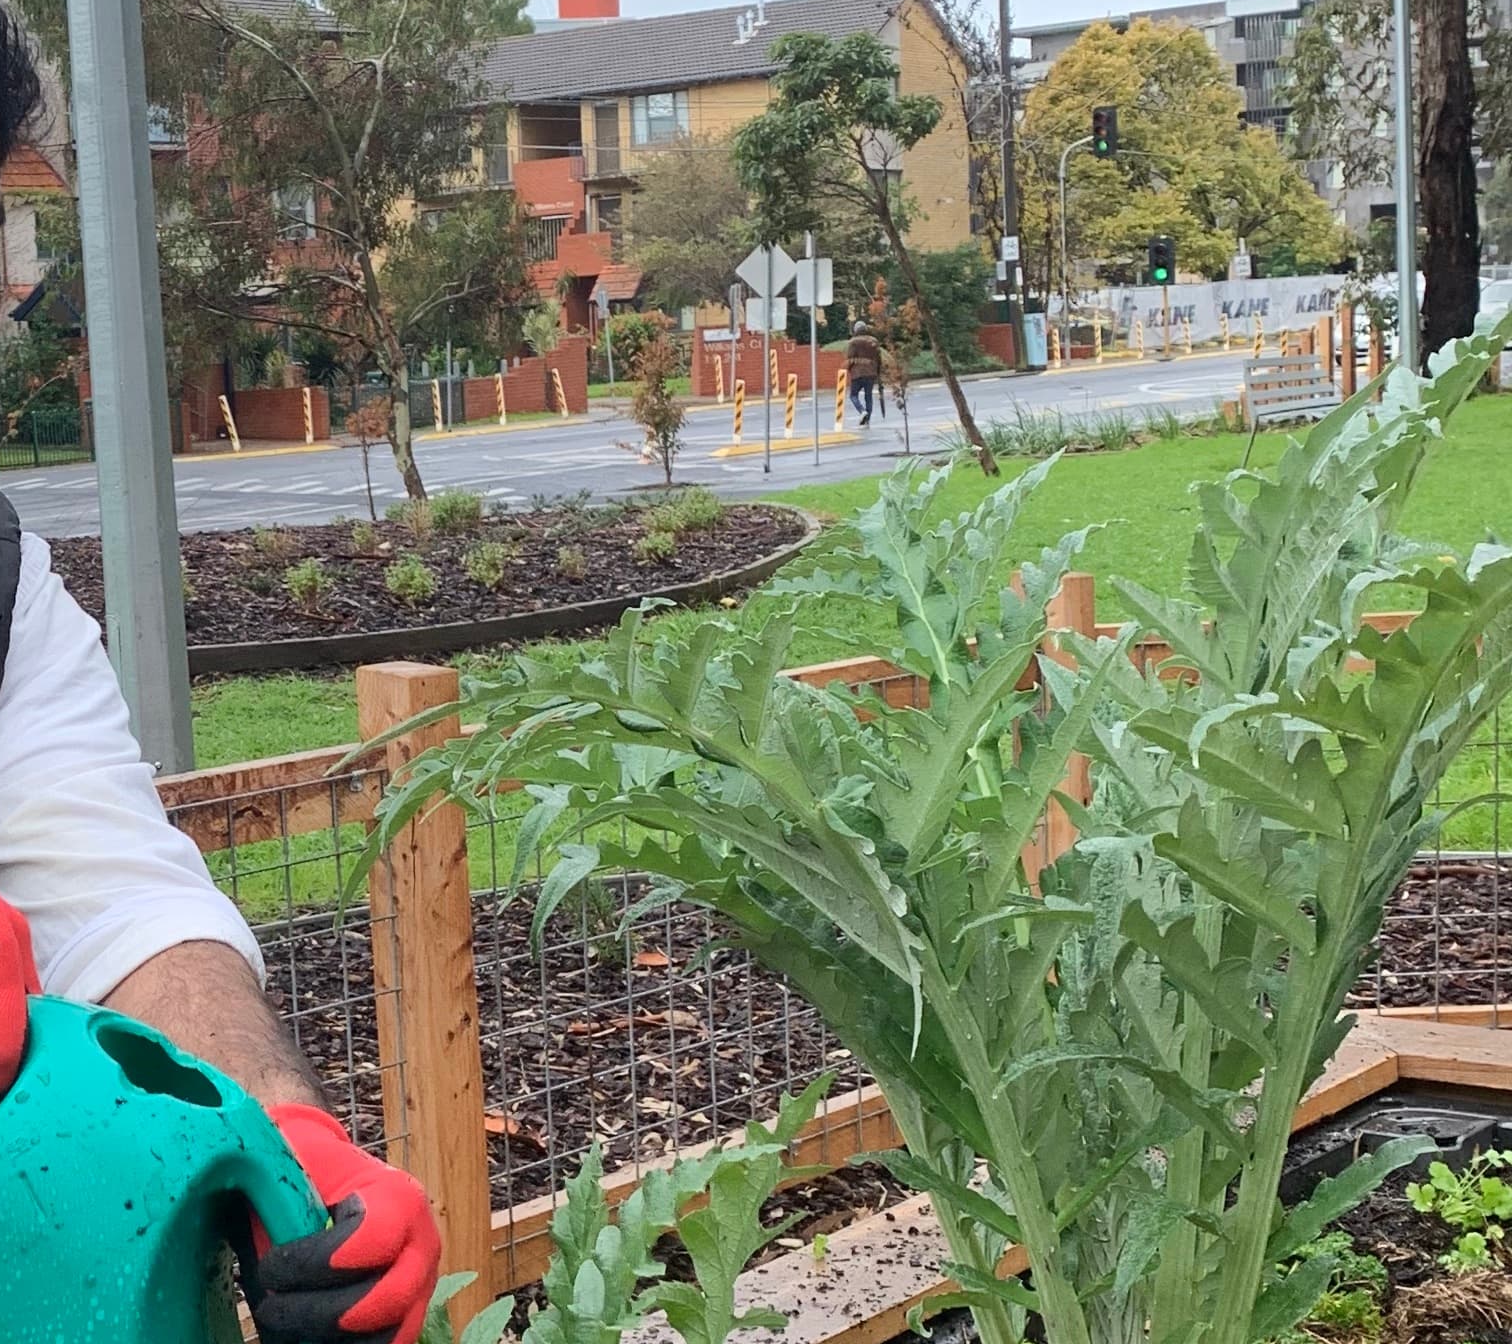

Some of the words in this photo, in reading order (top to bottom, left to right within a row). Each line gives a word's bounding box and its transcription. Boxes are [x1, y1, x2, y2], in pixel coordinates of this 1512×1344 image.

[1221, 297, 1271, 320] KANE
[1296, 289, 1337, 314] KANE
[1145, 304, 1197, 329] KANE
